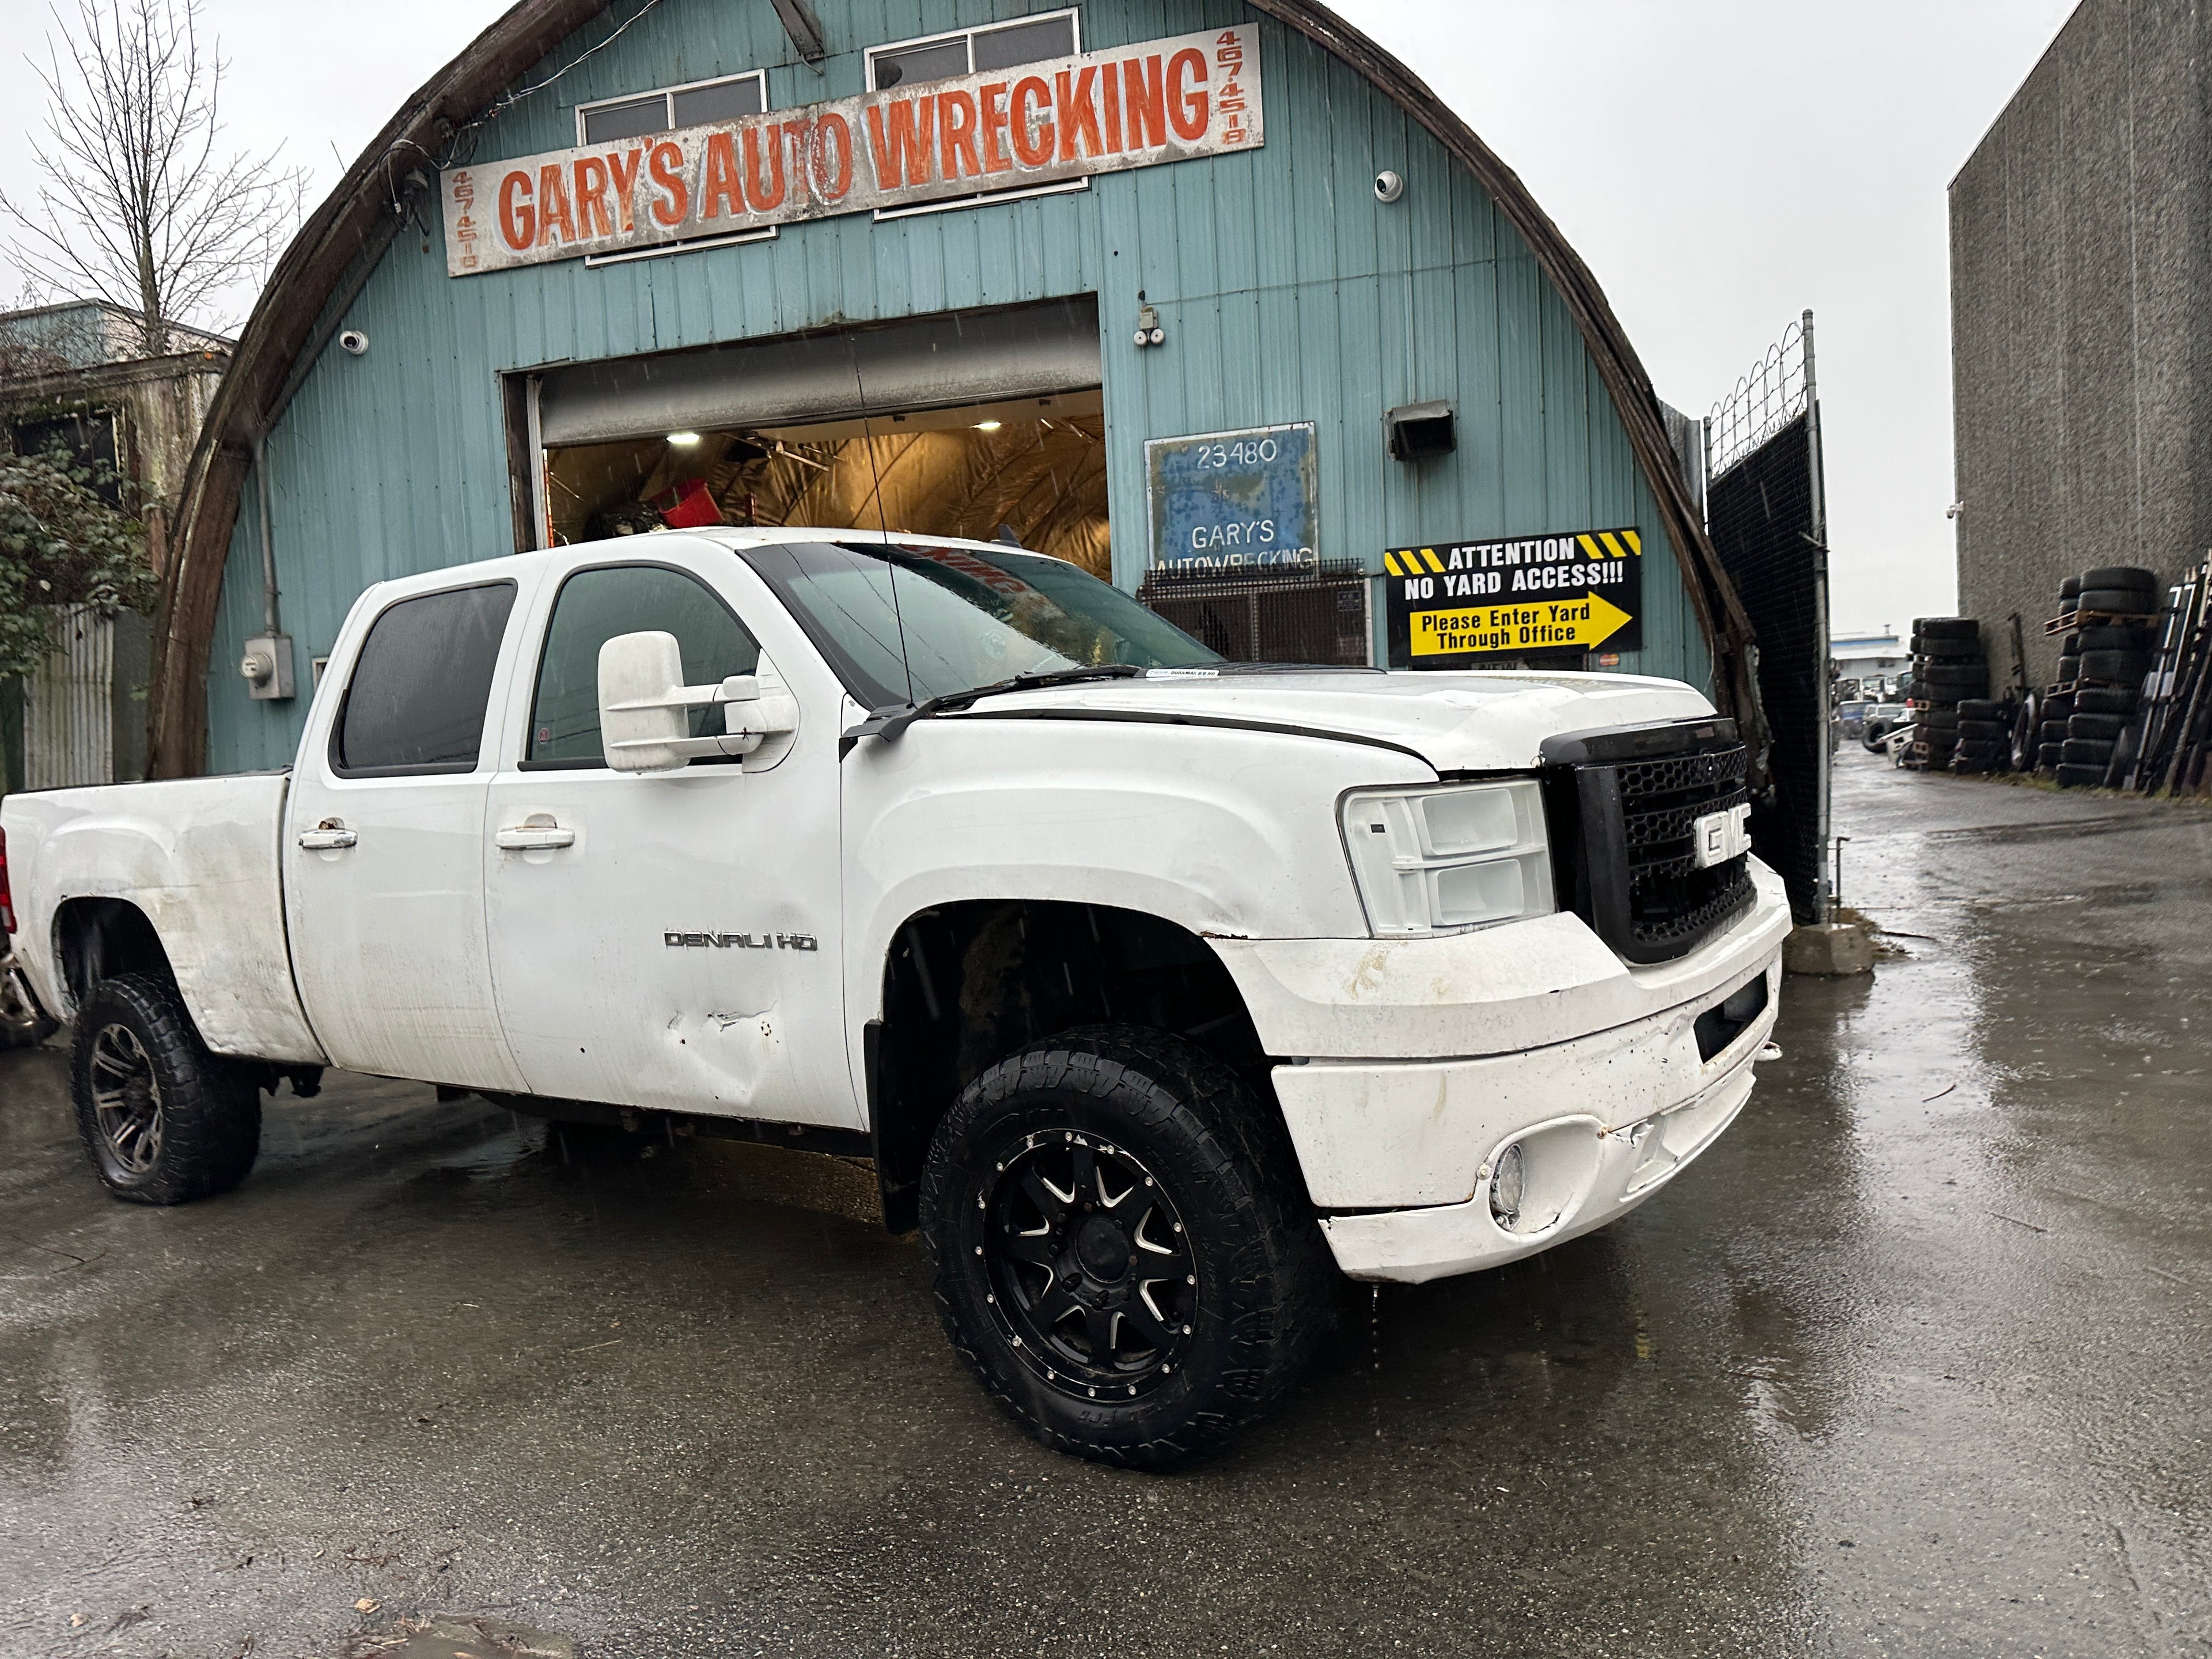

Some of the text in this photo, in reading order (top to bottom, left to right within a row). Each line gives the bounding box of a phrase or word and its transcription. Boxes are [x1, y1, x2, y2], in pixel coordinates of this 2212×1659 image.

[497, 48, 1209, 252] GARY'S AUTO WRECKING
[1198, 439, 1277, 469] 23480
[1192, 520, 1274, 548] GARY'S
[1448, 537, 1574, 570] ATTENTION
[1405, 561, 1623, 600] NO YARD ACCESS!!!
[1422, 603, 1590, 632] Please Enter Yard
[1437, 626, 1575, 650] Through Office
[1693, 802, 1752, 869] GMC
[664, 930, 818, 951] DENALI HD
